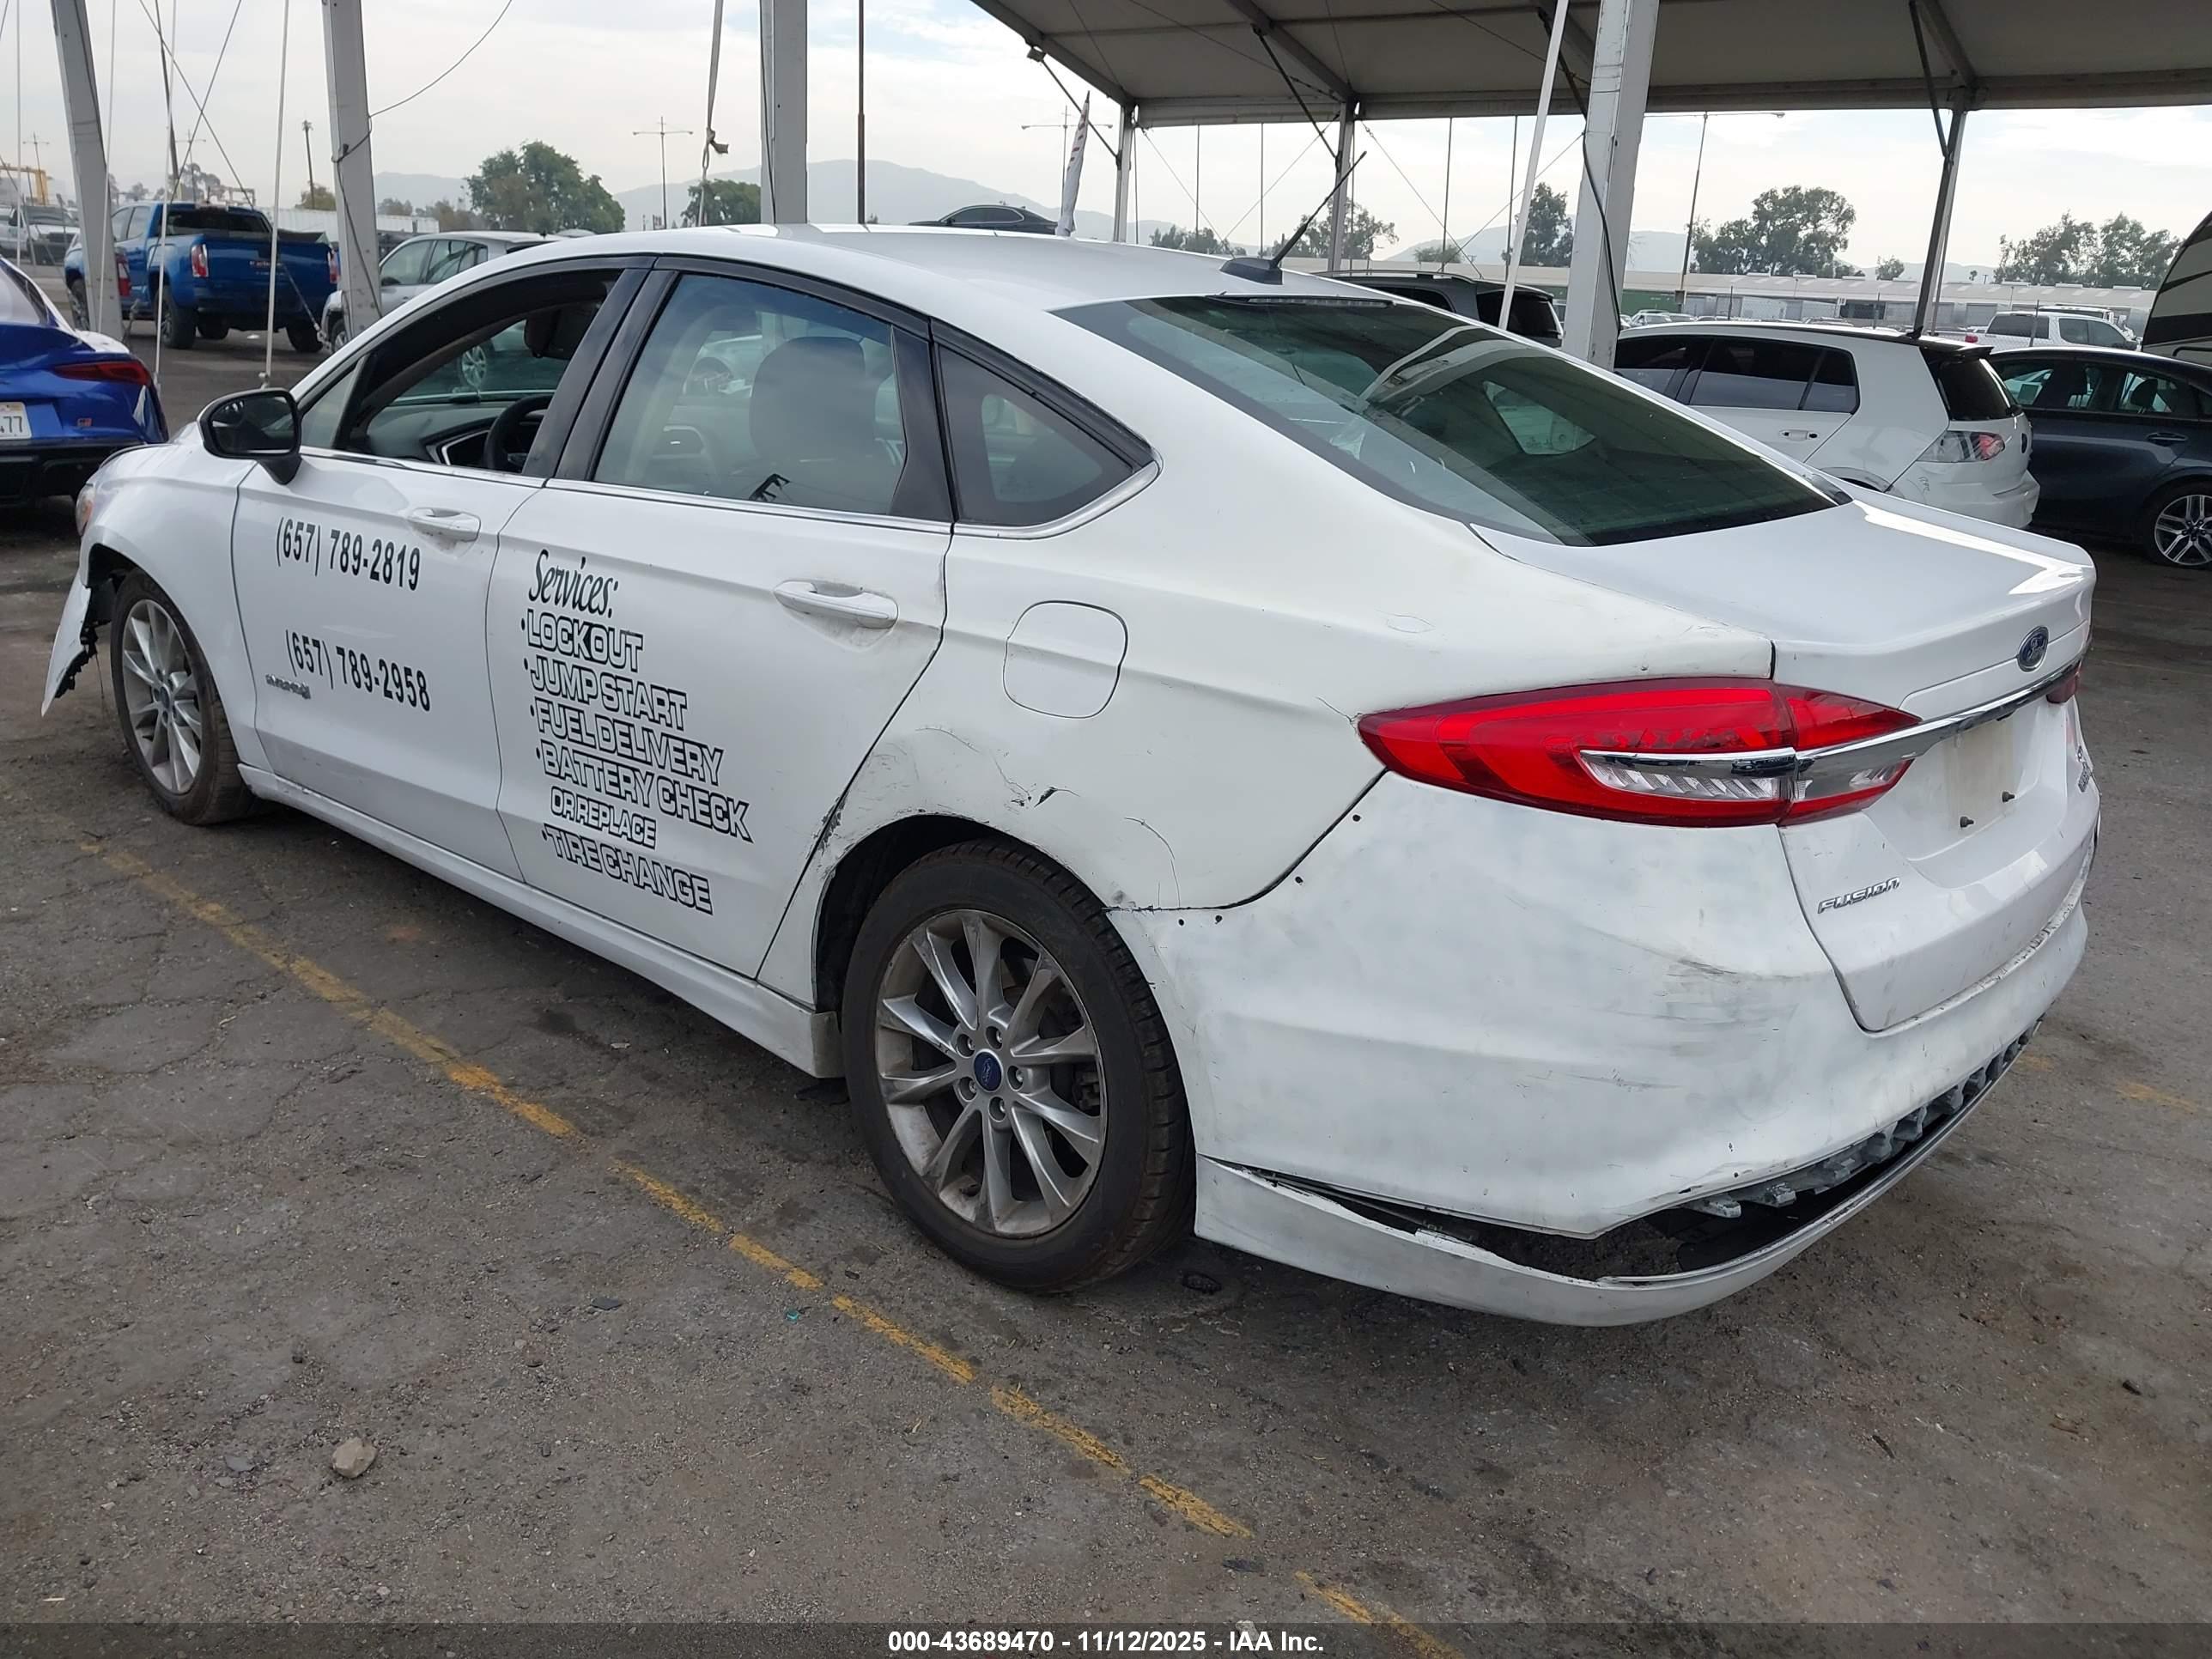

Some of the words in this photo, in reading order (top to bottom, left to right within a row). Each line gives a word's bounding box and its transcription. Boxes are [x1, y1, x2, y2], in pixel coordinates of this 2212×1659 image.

[0, 416, 23, 434] 77
[276, 517, 321, 577] (657)
[330, 529, 421, 591] 789-2819
[528, 549, 618, 618] Services:
[285, 629, 334, 690] (657)
[336, 645, 430, 712] 789-2958
[527, 608, 644, 673] LOCKOUT
[530, 654, 599, 705] JUMP
[599, 672, 688, 732] START
[534, 696, 597, 749] FUEL
[594, 714, 725, 787] DELIVERY
[540, 739, 655, 808] BATTERY
[657, 775, 754, 843] CHECK
[550, 786, 575, 821] OR
[575, 793, 657, 849] REPLACE
[544, 823, 604, 873] TIRE
[600, 843, 714, 915] CHANGE
